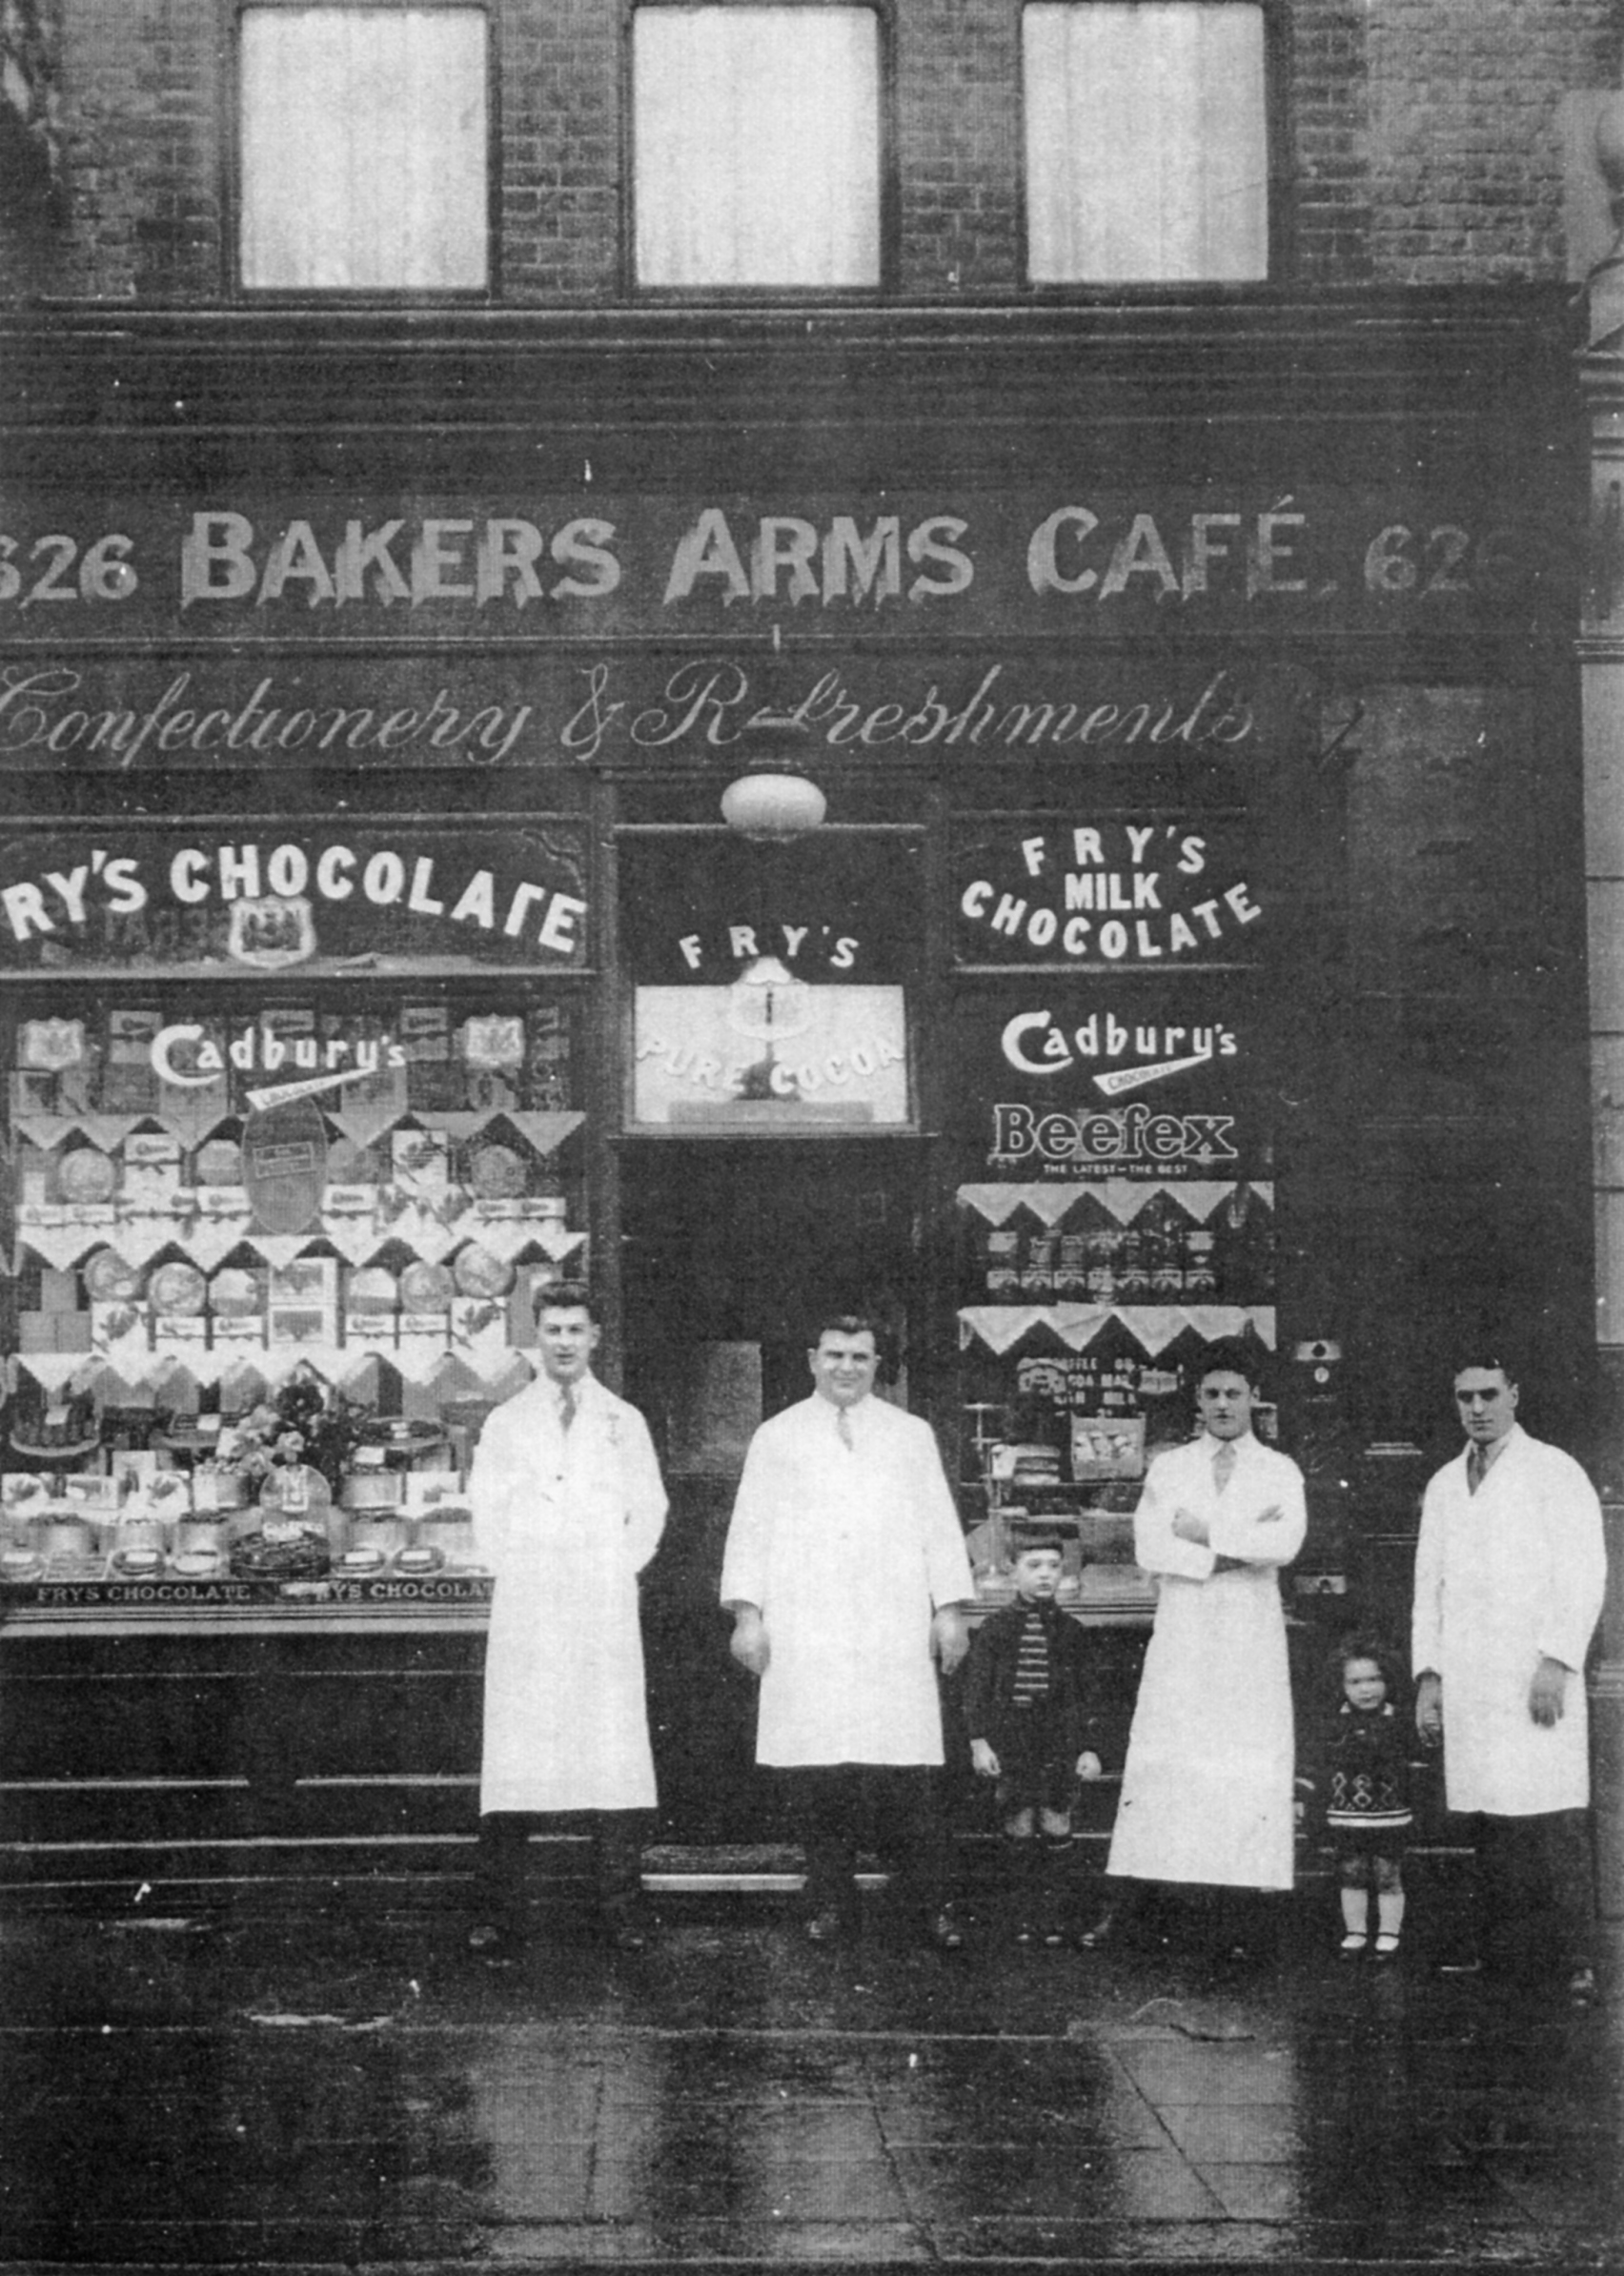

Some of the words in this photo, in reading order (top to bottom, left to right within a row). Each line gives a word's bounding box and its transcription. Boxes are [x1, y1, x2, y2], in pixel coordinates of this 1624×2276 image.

[180, 510, 622, 609] BAKERS
[662, 508, 975, 608] ARMS
[0, 665, 533, 770] Confectionery
[560, 662, 625, 761] &
[1022, 825, 1207, 876] FRY'S
[0, 848, 149, 942] RY'S
[170, 843, 588, 953] CHOCOLATE
[1065, 873, 1162, 910] MILK
[679, 925, 859, 969] FRY'S
[961, 883, 1263, 959] CHOCOLATE
[150, 1024, 408, 1087] Cadbury's
[636, 1037, 746, 1093] PURE
[769, 1037, 905, 1095] COCOA
[1002, 1010, 1238, 1074] Cadbury's
[993, 1102, 1239, 1160] Beefex
[1043, 1164, 1066, 1174] THE
[1157, 1164, 1188, 1174] BEST
[107, 1584, 252, 1601] CHOCOLATE
[369, 1581, 495, 1600] CHOCOLA
